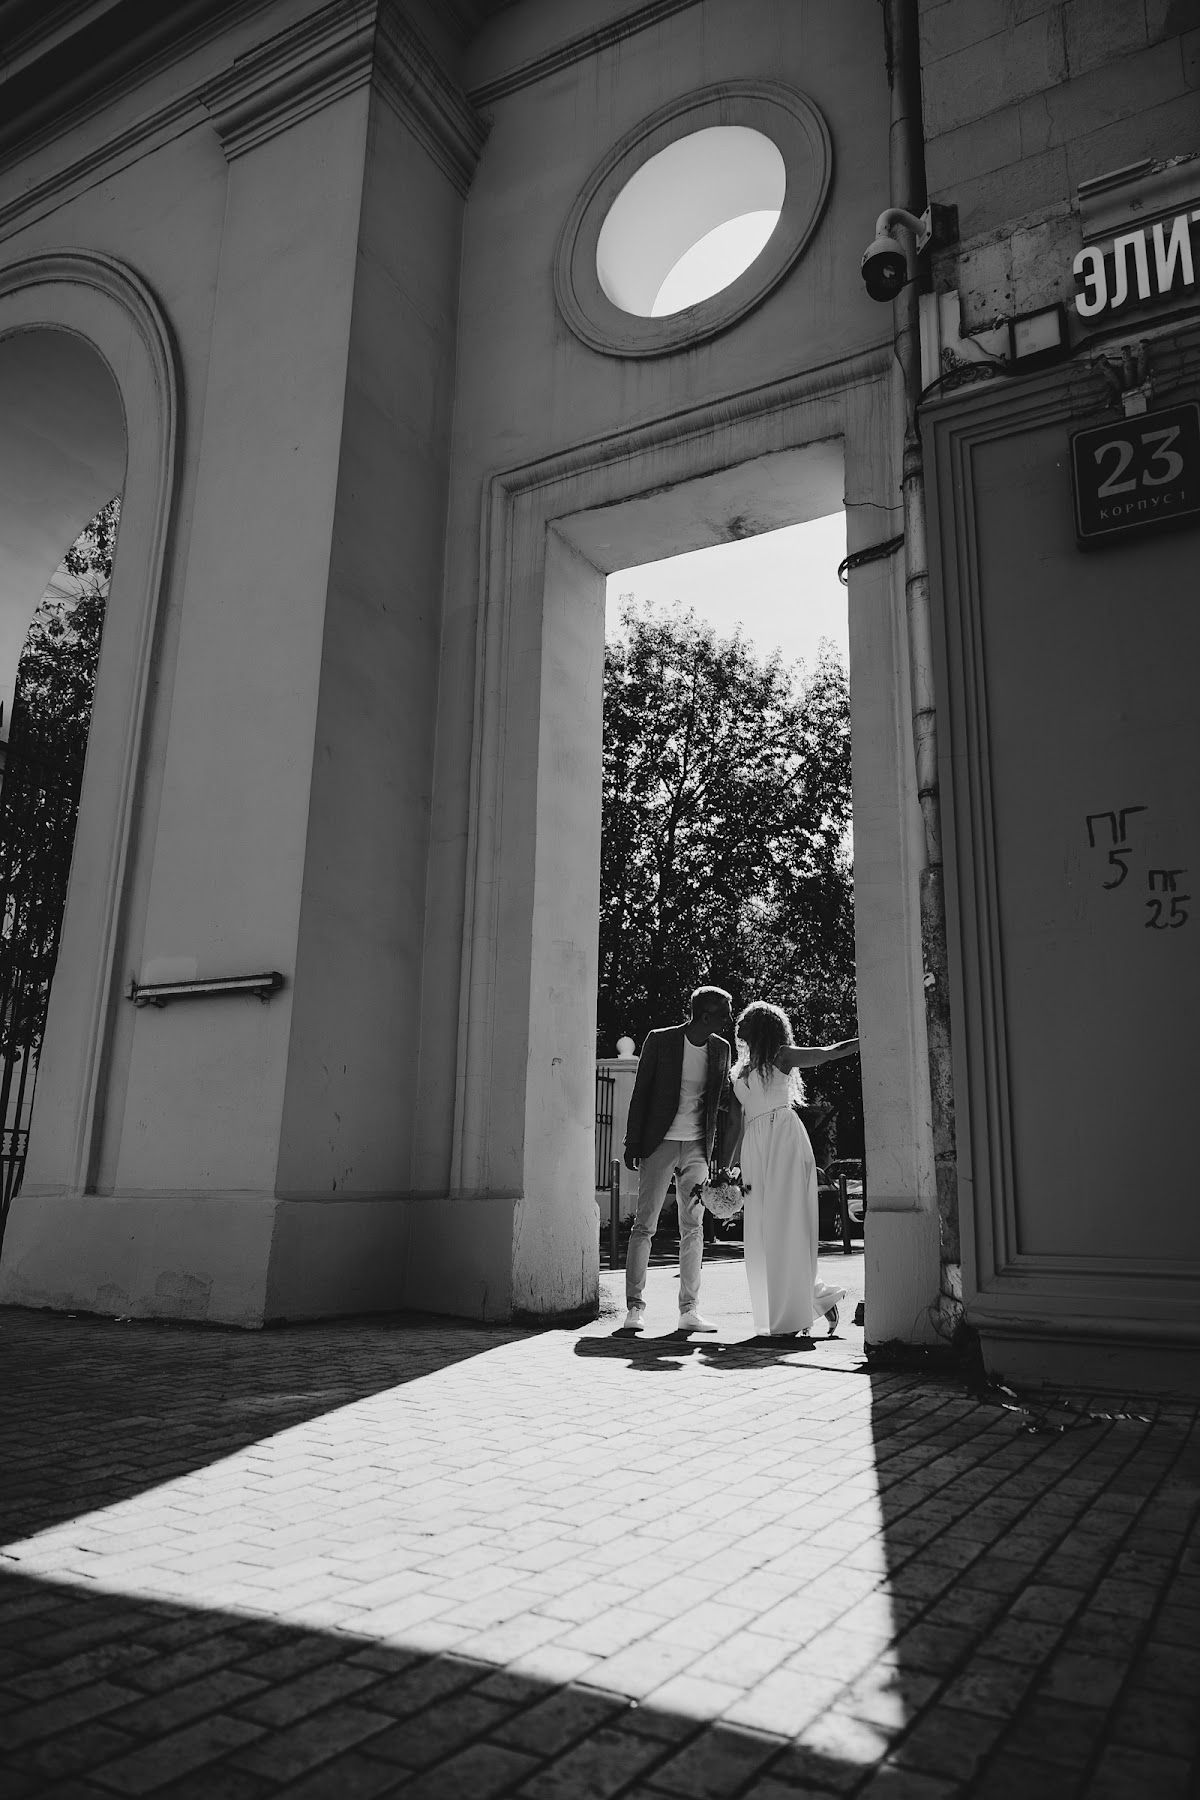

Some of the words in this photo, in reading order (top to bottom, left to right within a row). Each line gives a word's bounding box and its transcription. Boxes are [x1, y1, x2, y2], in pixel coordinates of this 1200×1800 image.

[1073, 209, 1200, 317] ЭЛИ
[1094, 425, 1184, 498] 23
[1100, 494, 1172, 519] КОРПУС
[1181, 491, 1185, 500] 1
[1102, 848, 1133, 890] 5
[1144, 895, 1191, 929] 25
